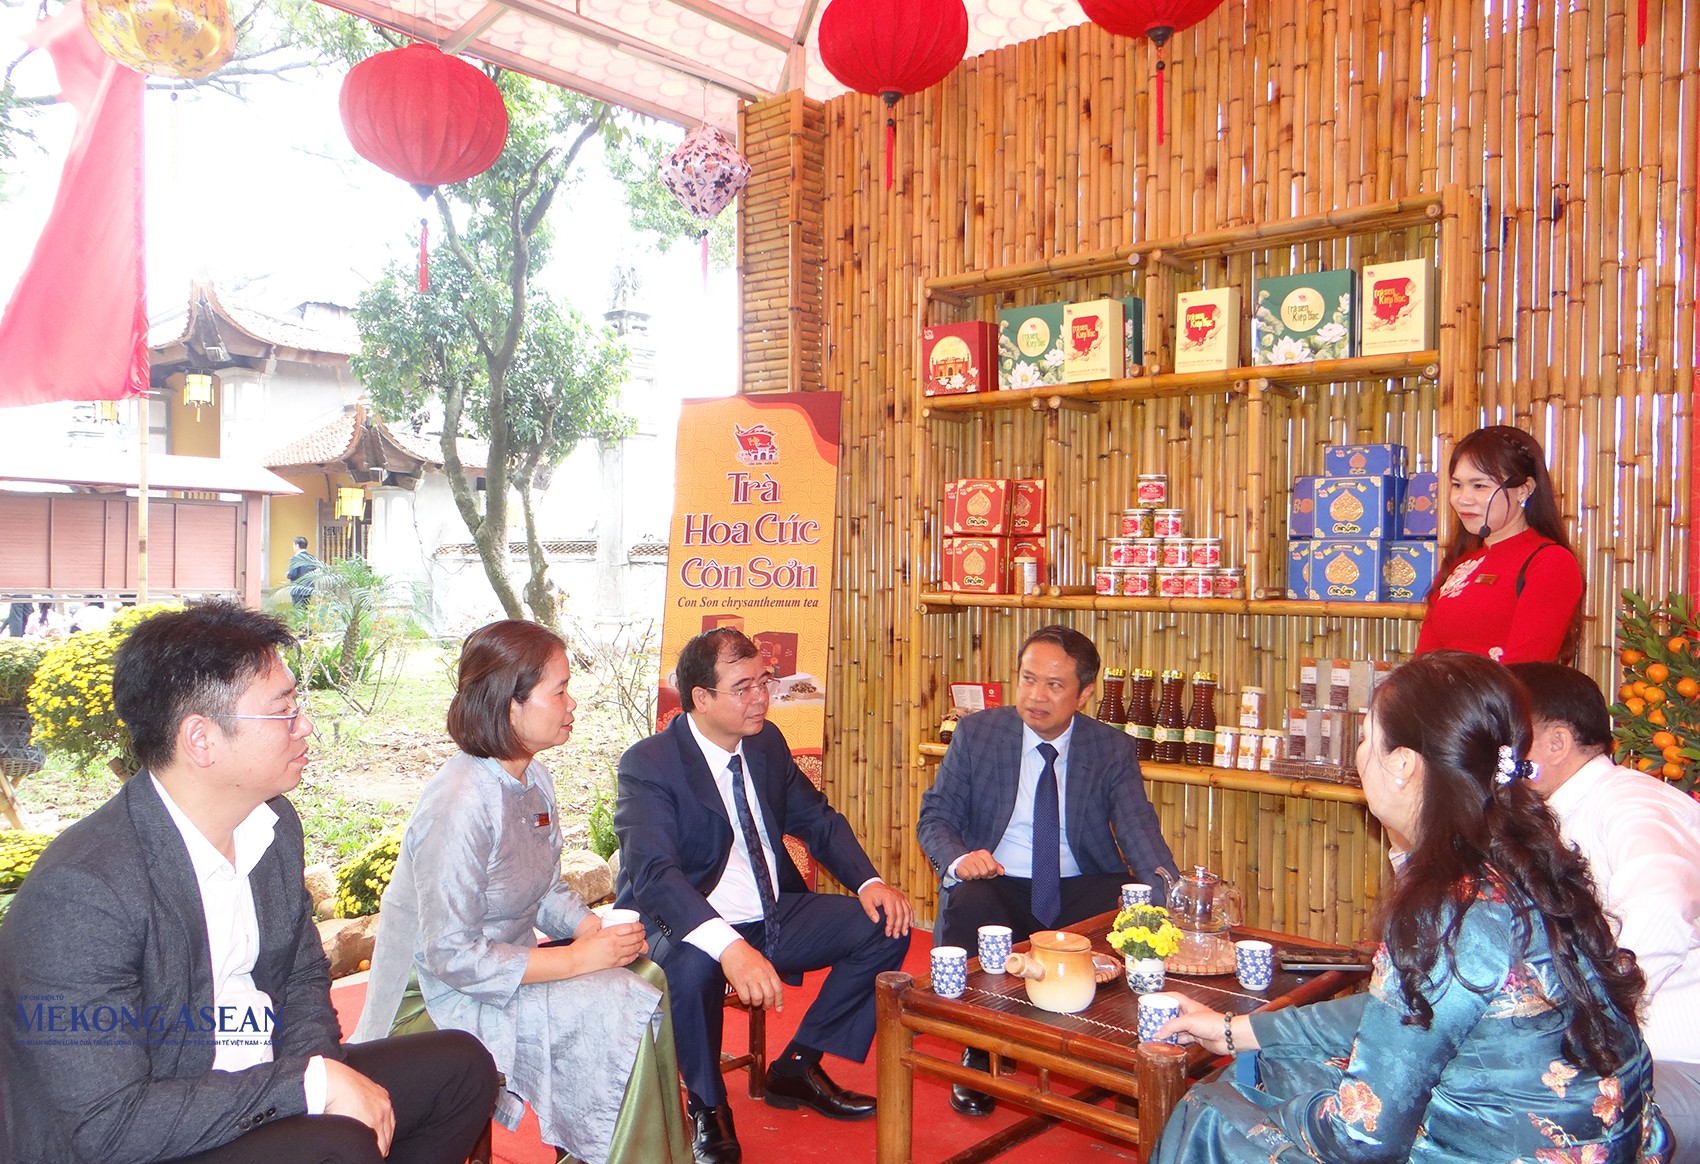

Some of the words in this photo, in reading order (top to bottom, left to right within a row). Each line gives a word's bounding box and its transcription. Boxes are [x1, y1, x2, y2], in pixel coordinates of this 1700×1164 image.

[727, 472, 780, 503] Trà
[683, 513, 750, 545] Hoa
[754, 512, 820, 545] Cúc
[680, 557, 744, 589] Côn
[748, 557, 819, 589] Sơn
[677, 597, 697, 608] Con
[699, 596, 719, 608] Son
[721, 596, 800, 610] chrysanthemum
[803, 598, 819, 608] tea
